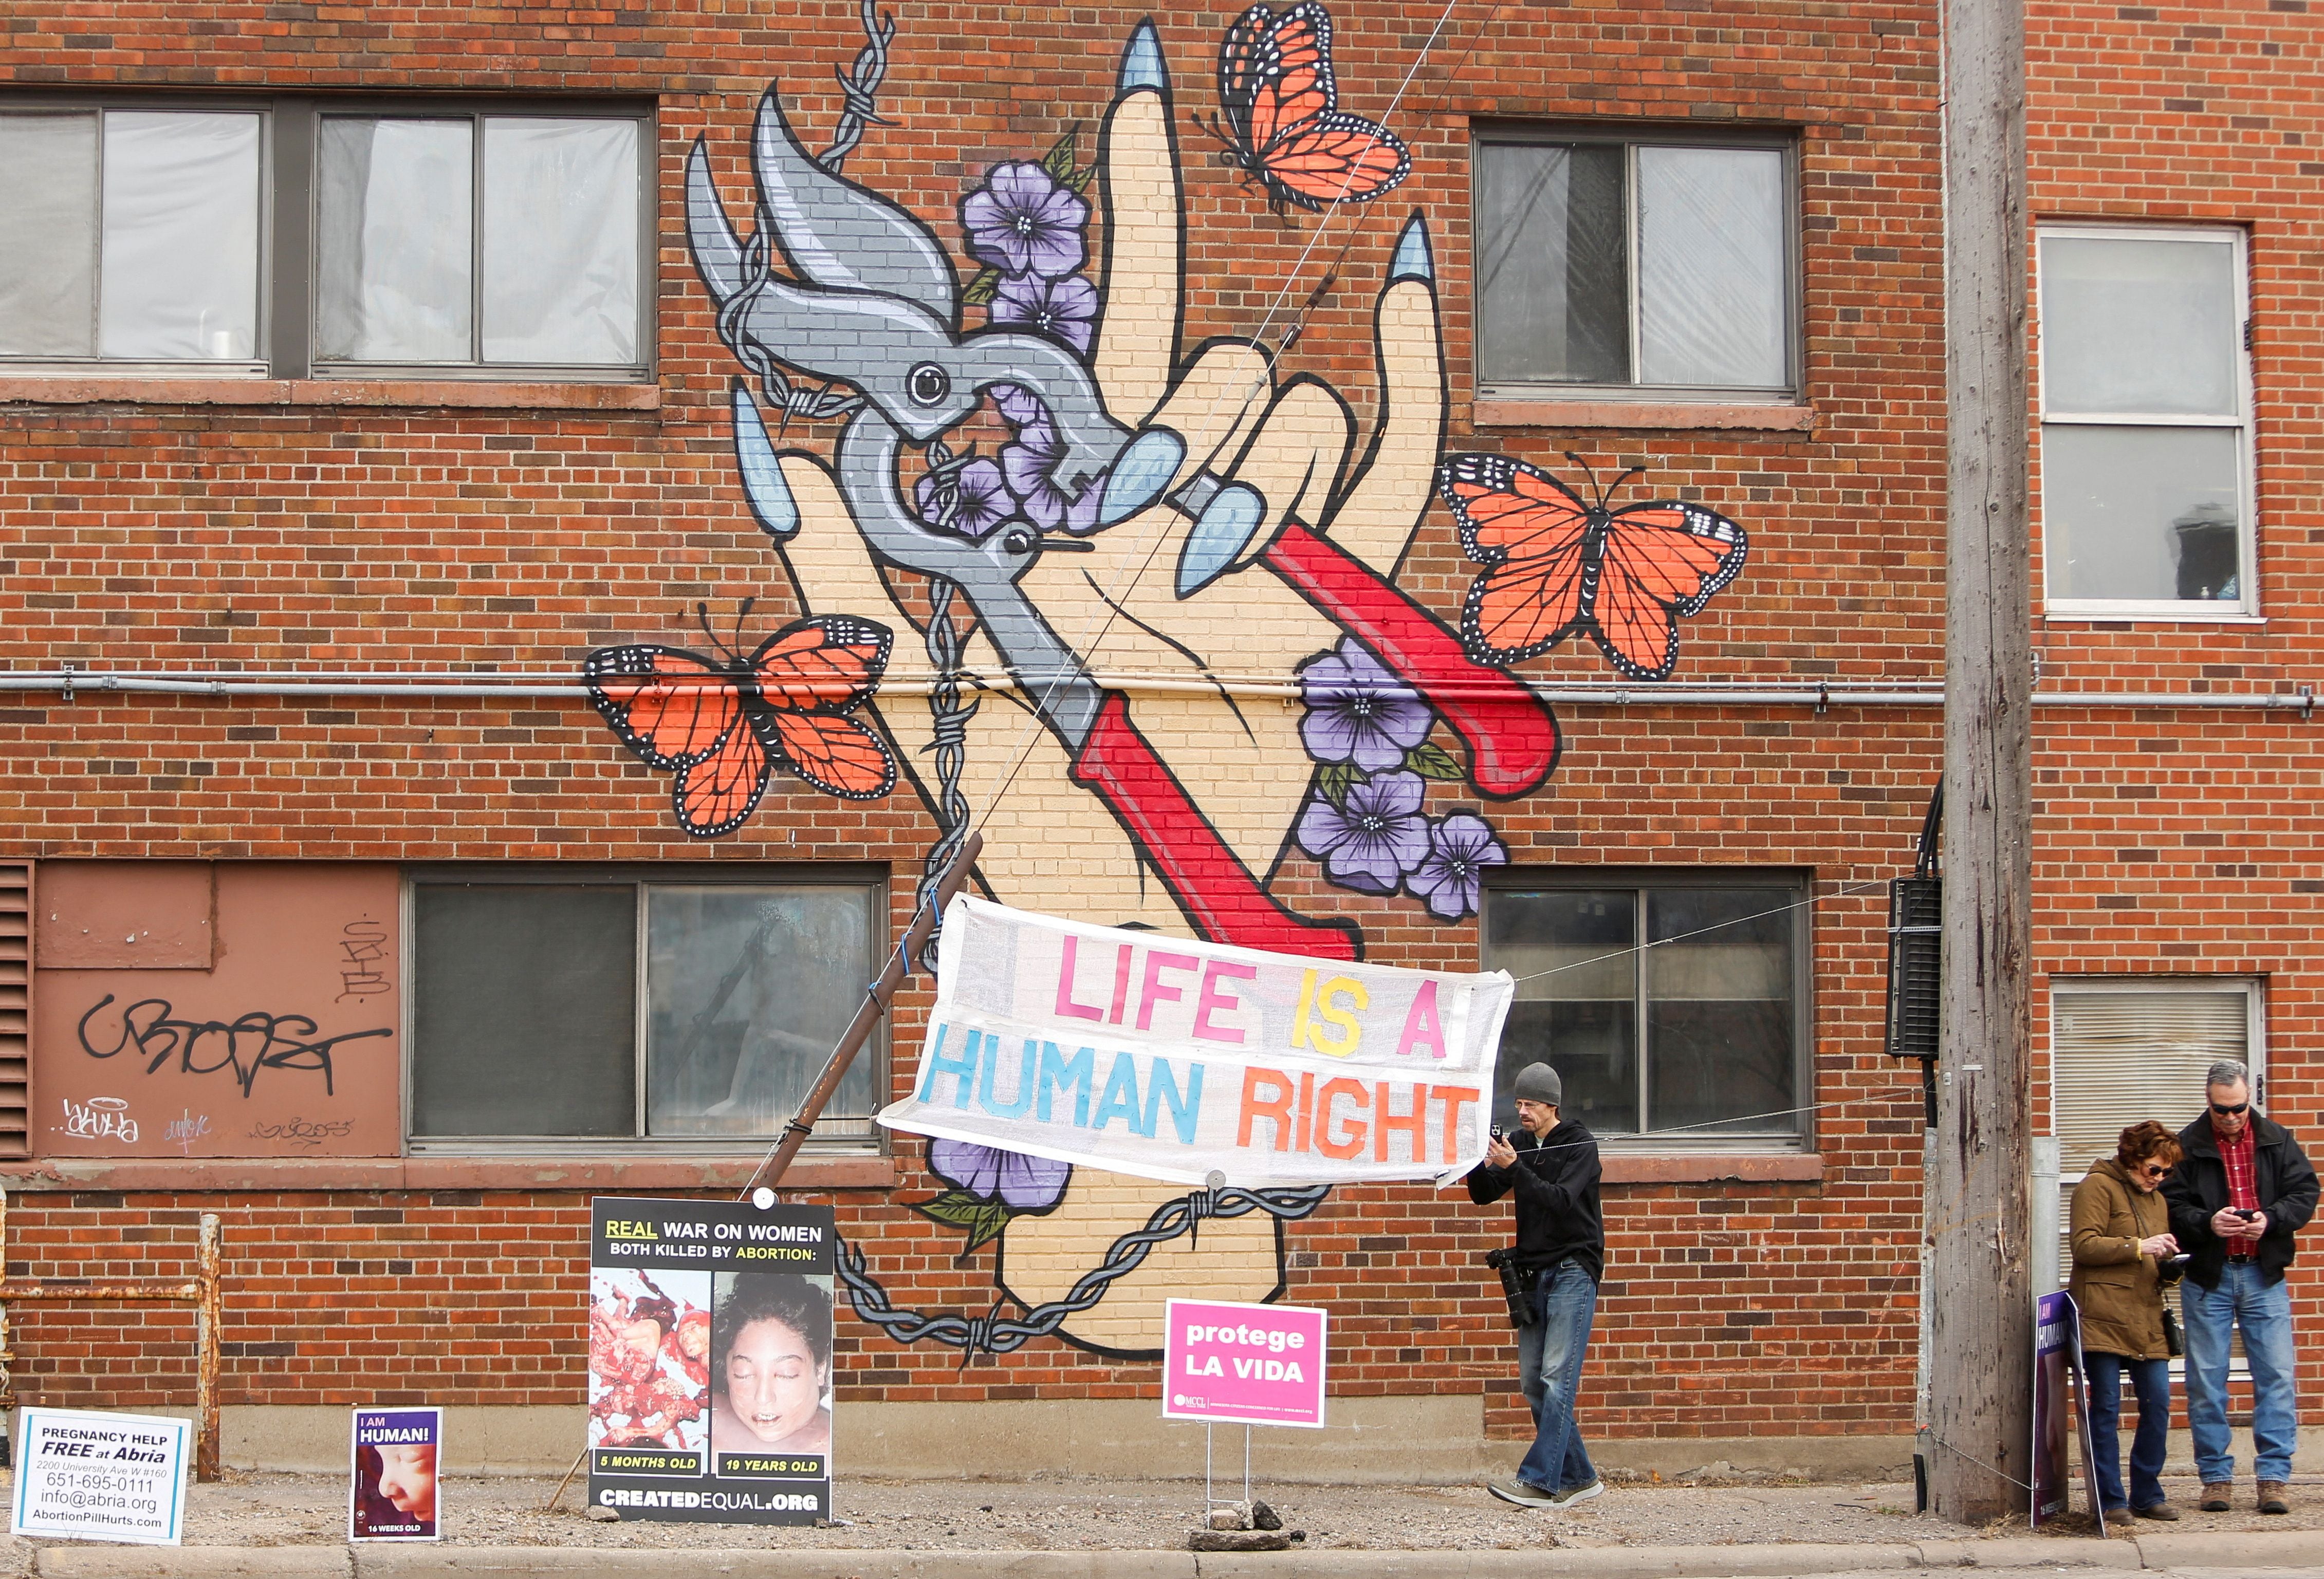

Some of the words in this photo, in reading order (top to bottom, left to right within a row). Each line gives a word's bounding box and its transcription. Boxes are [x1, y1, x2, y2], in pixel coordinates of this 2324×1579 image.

[1055, 935, 1257, 1043] LIFE
[1291, 968, 1369, 1058] IS
[1396, 979, 1446, 1058] A
[918, 1023, 1204, 1145] HUMAN
[1237, 1066, 1479, 1164] RIGHT
[605, 1220, 658, 1238] REAL
[663, 1222, 708, 1239] WAR
[714, 1223, 742, 1240] ON
[748, 1225, 822, 1242] WOMEN
[611, 1243, 650, 1255] BOTH
[655, 1243, 707, 1257] KILLED
[712, 1246, 731, 1258] BY
[735, 1247, 817, 1261] ABORTION:
[2042, 1303, 2051, 1320] AM
[1187, 1324, 1304, 1352] protege
[1186, 1355, 1224, 1376] LA
[1233, 1358, 1304, 1383] VIDA
[1185, 1396, 1206, 1406] MCCL
[360, 1418, 364, 1427] I
[366, 1417, 385, 1427] AM
[42, 1428, 127, 1443] PREGNANCY
[132, 1434, 168, 1446] HELP
[360, 1427, 429, 1443] HUMAN!
[42, 1442, 94, 1458] FREE
[96, 1450, 109, 1459] at
[113, 1446, 165, 1464] Abria
[36, 1460, 60, 1470] 2200
[63, 1463, 107, 1475] University
[109, 1466, 127, 1475] Ave
[131, 1467, 141, 1476] W
[143, 1468, 167, 1478] #160
[600, 1456, 608, 1467] 5
[612, 1456, 666, 1469] MONTHS
[670, 1458, 697, 1470] OLD
[726, 1460, 740, 1471] 19
[745, 1460, 787, 1472] YEARS
[791, 1461, 818, 1473] OLD
[47, 1472, 153, 1493] 651-695-0111
[41, 1489, 157, 1513] info@abria.org
[599, 1489, 818, 1512] CREATEDEQUAL.ORG
[33, 1509, 161, 1528] AbortionPillHurts.com
